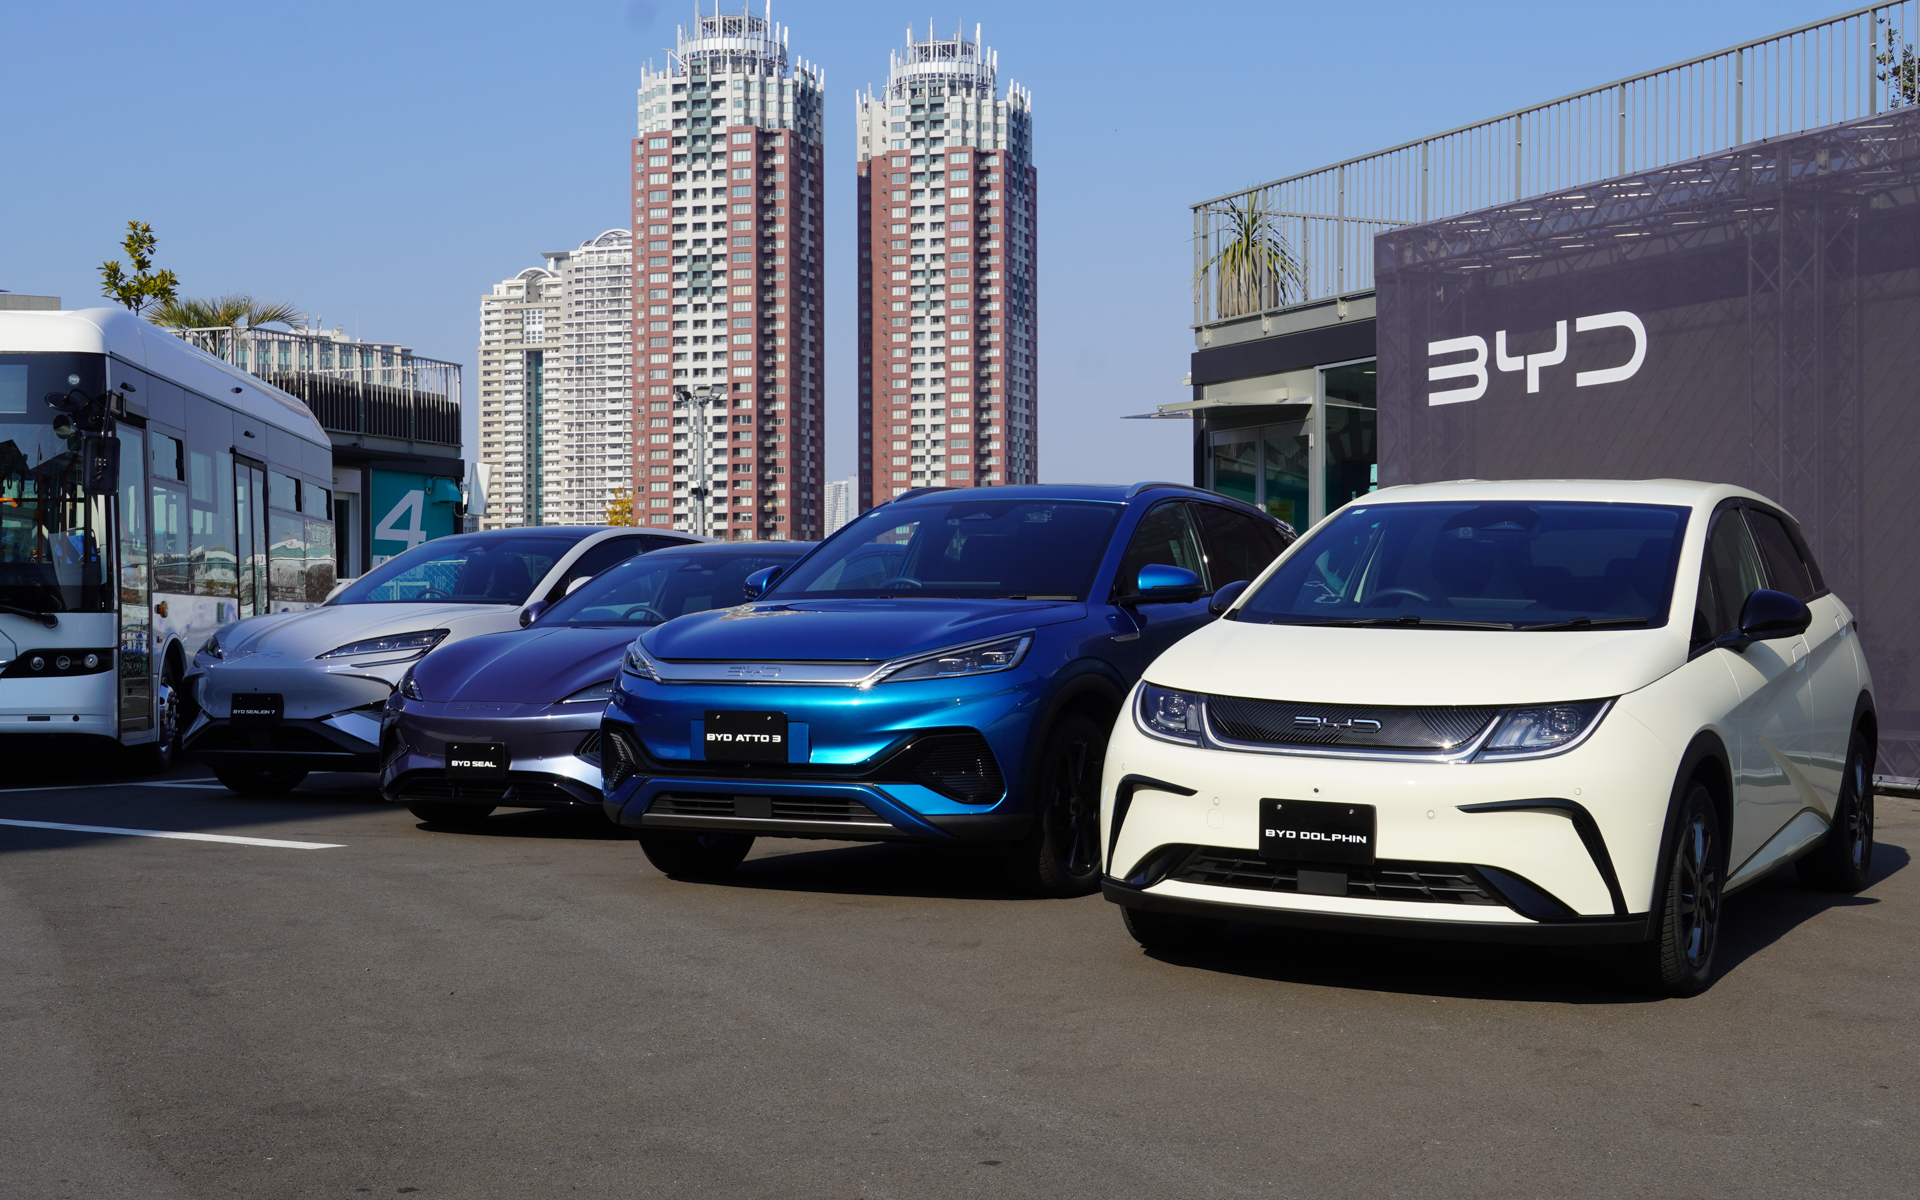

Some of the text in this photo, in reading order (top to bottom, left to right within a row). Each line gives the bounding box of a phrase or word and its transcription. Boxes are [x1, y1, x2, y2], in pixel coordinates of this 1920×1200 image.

[1428, 311, 1647, 408] BYD
[374, 489, 427, 550] 4
[726, 665, 782, 677] BYD
[1294, 716, 1382, 734] BYD
[706, 732, 782, 743] BYD ATTO 3
[451, 759, 497, 768] BYD SEAL
[1265, 828, 1367, 844] BYD DOLPHIN
